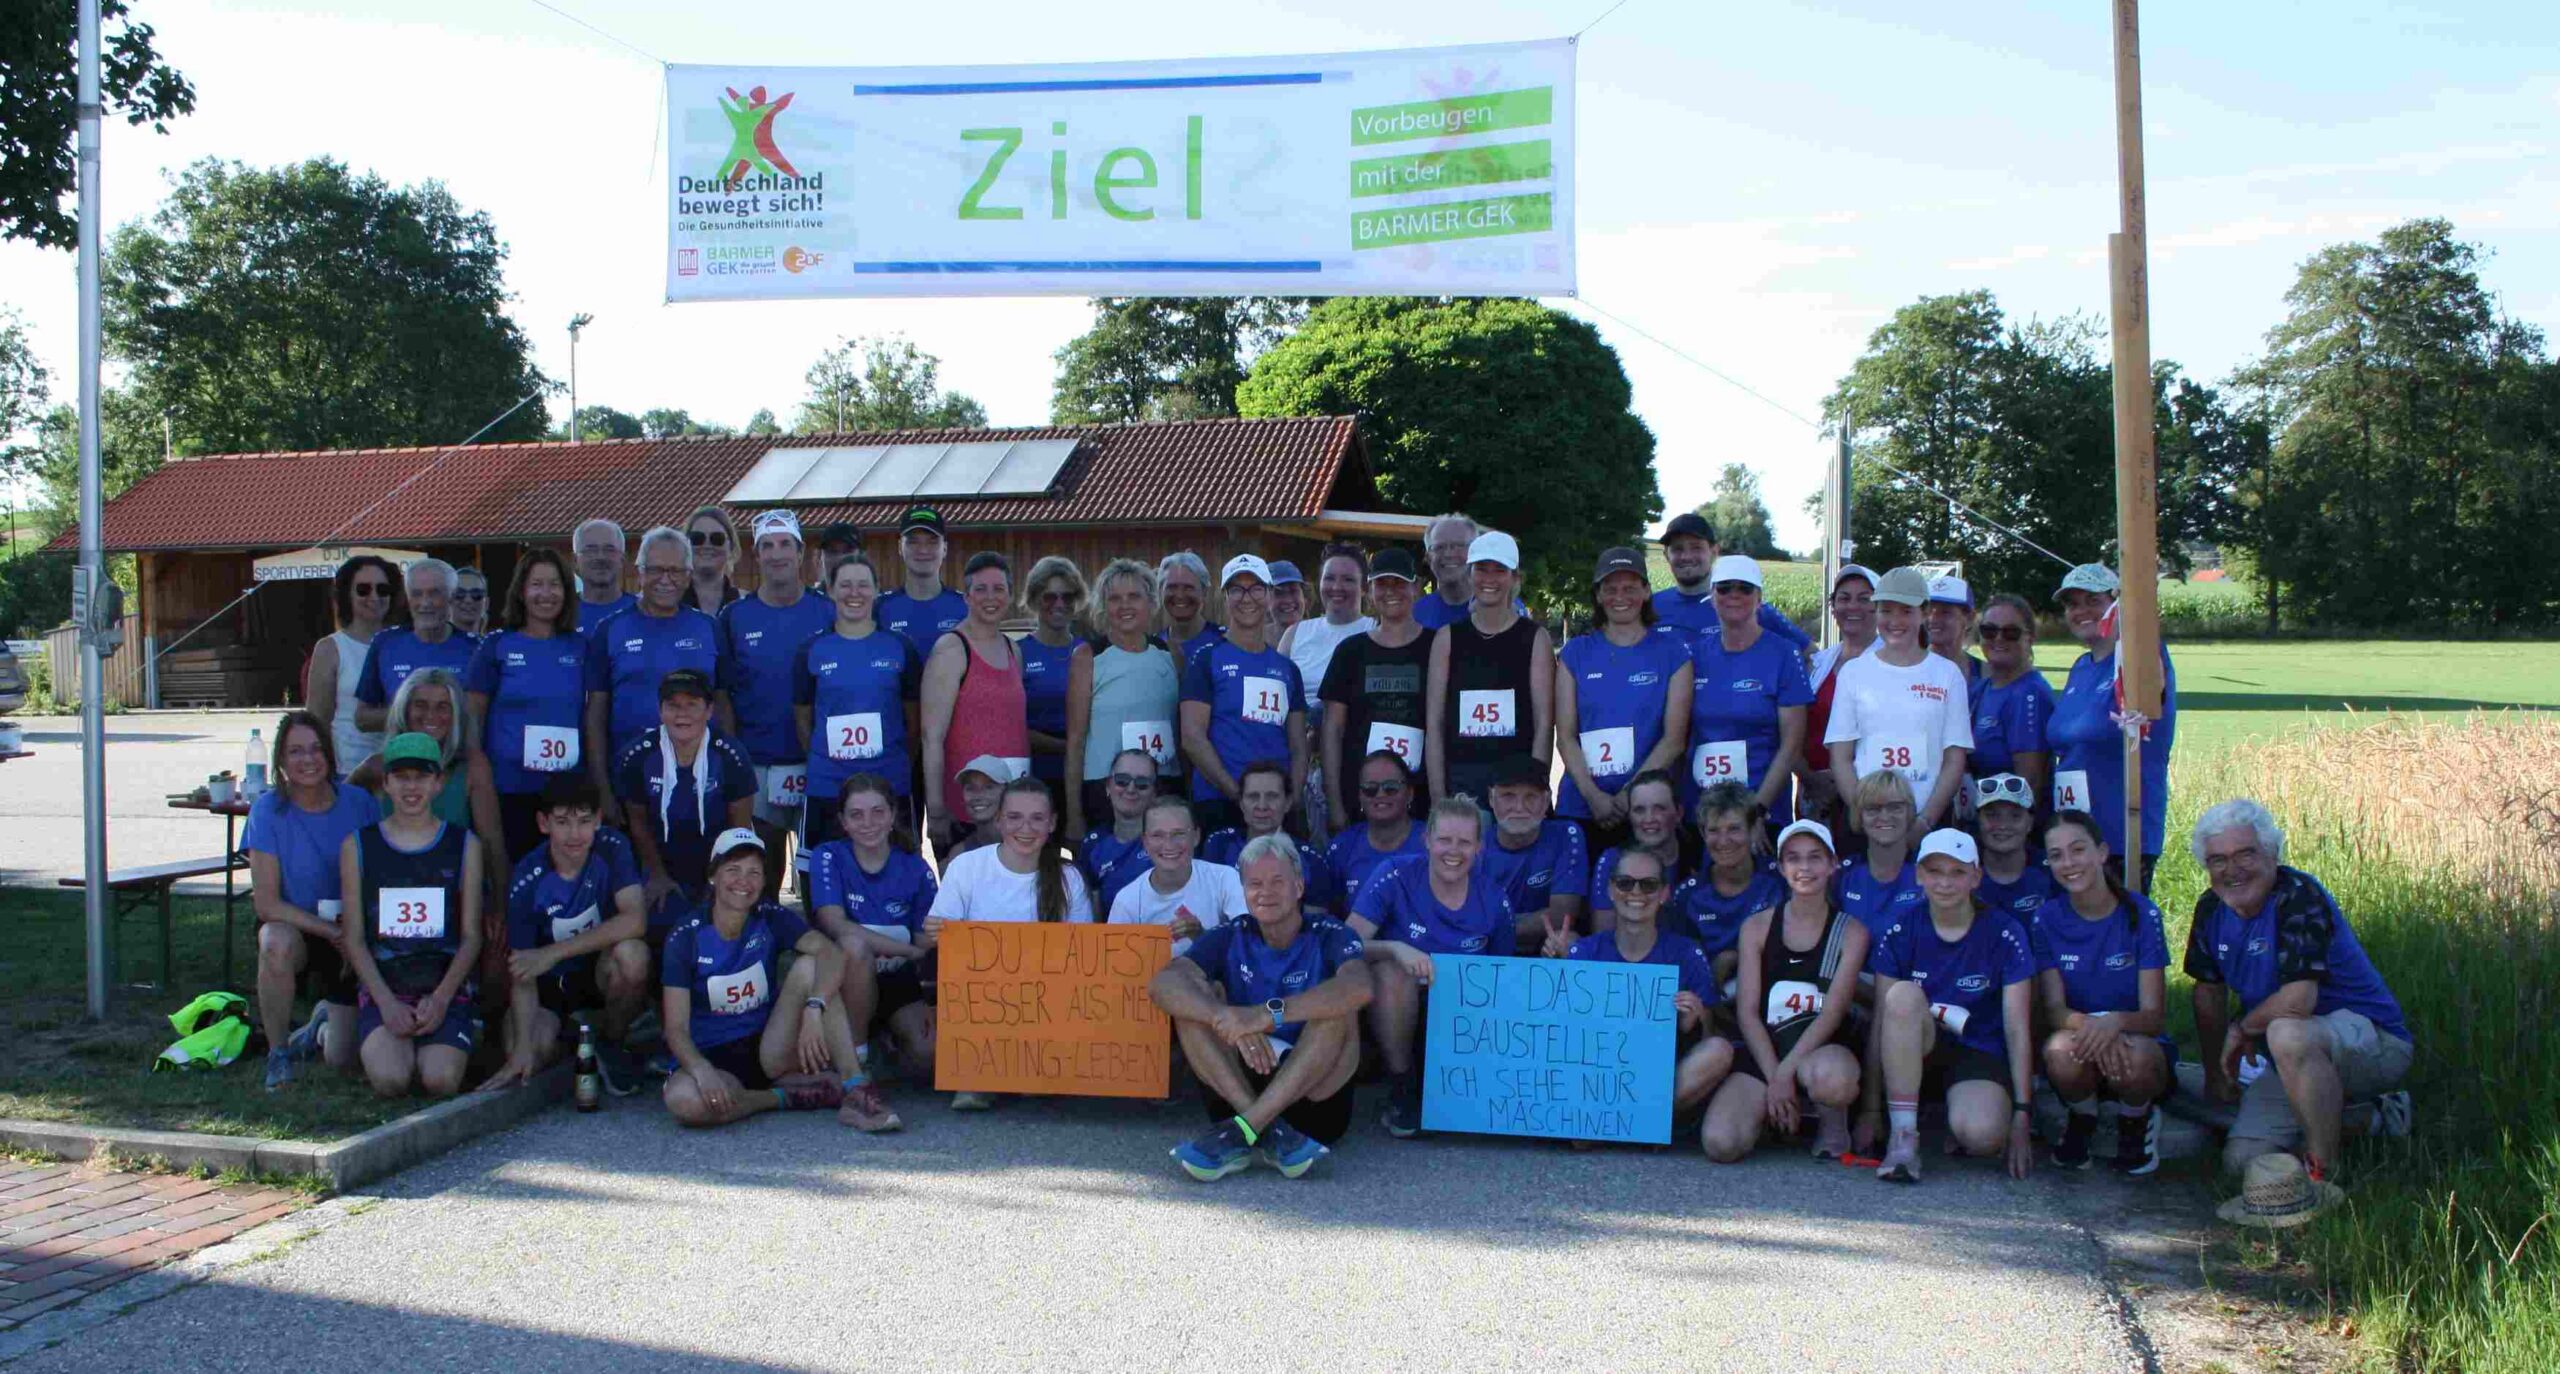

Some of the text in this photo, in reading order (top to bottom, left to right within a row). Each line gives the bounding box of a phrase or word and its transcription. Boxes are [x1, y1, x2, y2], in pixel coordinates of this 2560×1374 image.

[1358, 103, 1493, 136] Vorbeugen
[957, 115, 1203, 220] Ziel
[1358, 165, 1396, 188] mit
[1404, 161, 1444, 183] der
[678, 172, 824, 194] Deutschland
[678, 193, 824, 218] bewegt sich!
[678, 218, 824, 231] Die Gesundheitsinitiative
[1359, 208, 1460, 240] BARMER
[1467, 202, 1516, 228] GEK
[706, 246, 775, 260] BARMER
[794, 253, 825, 267] ZDF
[706, 262, 739, 276] GEK
[323, 547, 351, 561] DJK
[254, 565, 339, 580] SPORTVEREIN
[1258, 690, 1281, 712] 11
[1472, 703, 1500, 723] 45
[841, 726, 869, 746] 20
[1138, 733, 1163, 752] 14
[1383, 736, 1410, 758] 35
[539, 738, 567, 759] 30
[1599, 742, 1613, 762] 2
[1881, 747, 1912, 769] 38
[1704, 755, 1732, 776] 55
[782, 774, 807, 793] 49
[396, 902, 428, 923] 33
[966, 924, 1169, 977] DU LÄUFST
[726, 980, 756, 1004] 54
[1457, 962, 1677, 1022] IST DAS EINE
[941, 981, 1052, 1026] BESSER
[1066, 983, 1110, 1022] ALS
[1784, 993, 1815, 1014] 41
[1452, 1015, 1630, 1069] BAUSTELLE?
[951, 1038, 1162, 1083] DATING-LEBEN
[1440, 1065, 1637, 1105] ICH SEHE NUR
[1487, 1097, 1635, 1136] MASCHINEN
